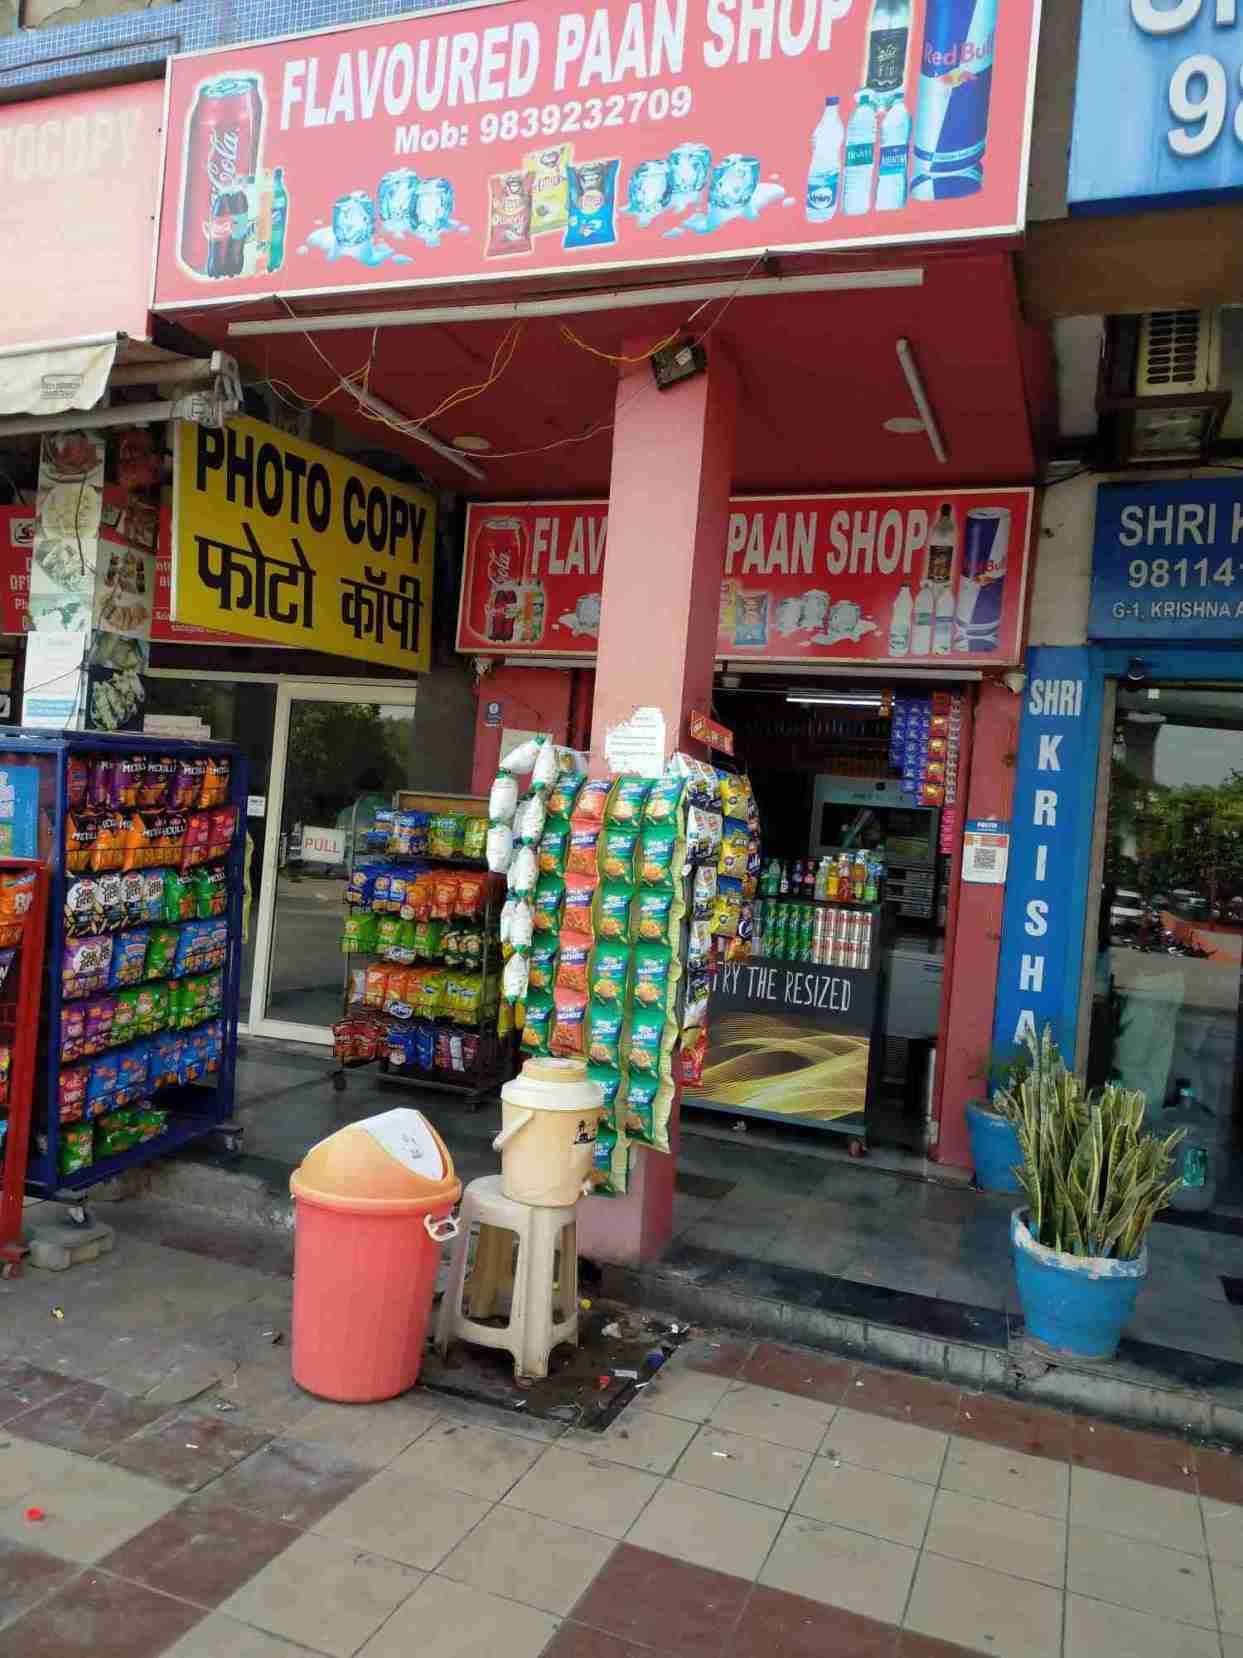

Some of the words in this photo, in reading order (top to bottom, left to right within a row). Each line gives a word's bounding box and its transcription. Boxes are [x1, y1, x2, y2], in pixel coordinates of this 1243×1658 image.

[280, 20, 541, 130] FLAVOURED
[553, 0, 688, 91] PAAN
[703, 0, 853, 69] SHOP
[394, 121, 469, 155] Mob:
[479, 85, 692, 143] 9839232709
[1167, 53, 1243, 157] 9
[196, 426, 331, 533] PHOTO
[343, 475, 427, 564] COPY
[1119, 502, 1217, 547] SHRI
[724, 512, 817, 575] PAAN
[827, 509, 929, 576] SHOP
[194, 521, 317, 629] फोटो
[340, 565, 424, 653] कॉपी
[1151, 601, 1232, 619] KRISHNA
[1029, 679, 1083, 716] SHRI
[303, 837, 341, 855] PULL
[711, 960, 744, 996] TRY
[747, 965, 779, 1000] THE
[784, 970, 852, 1012] RESIZED
